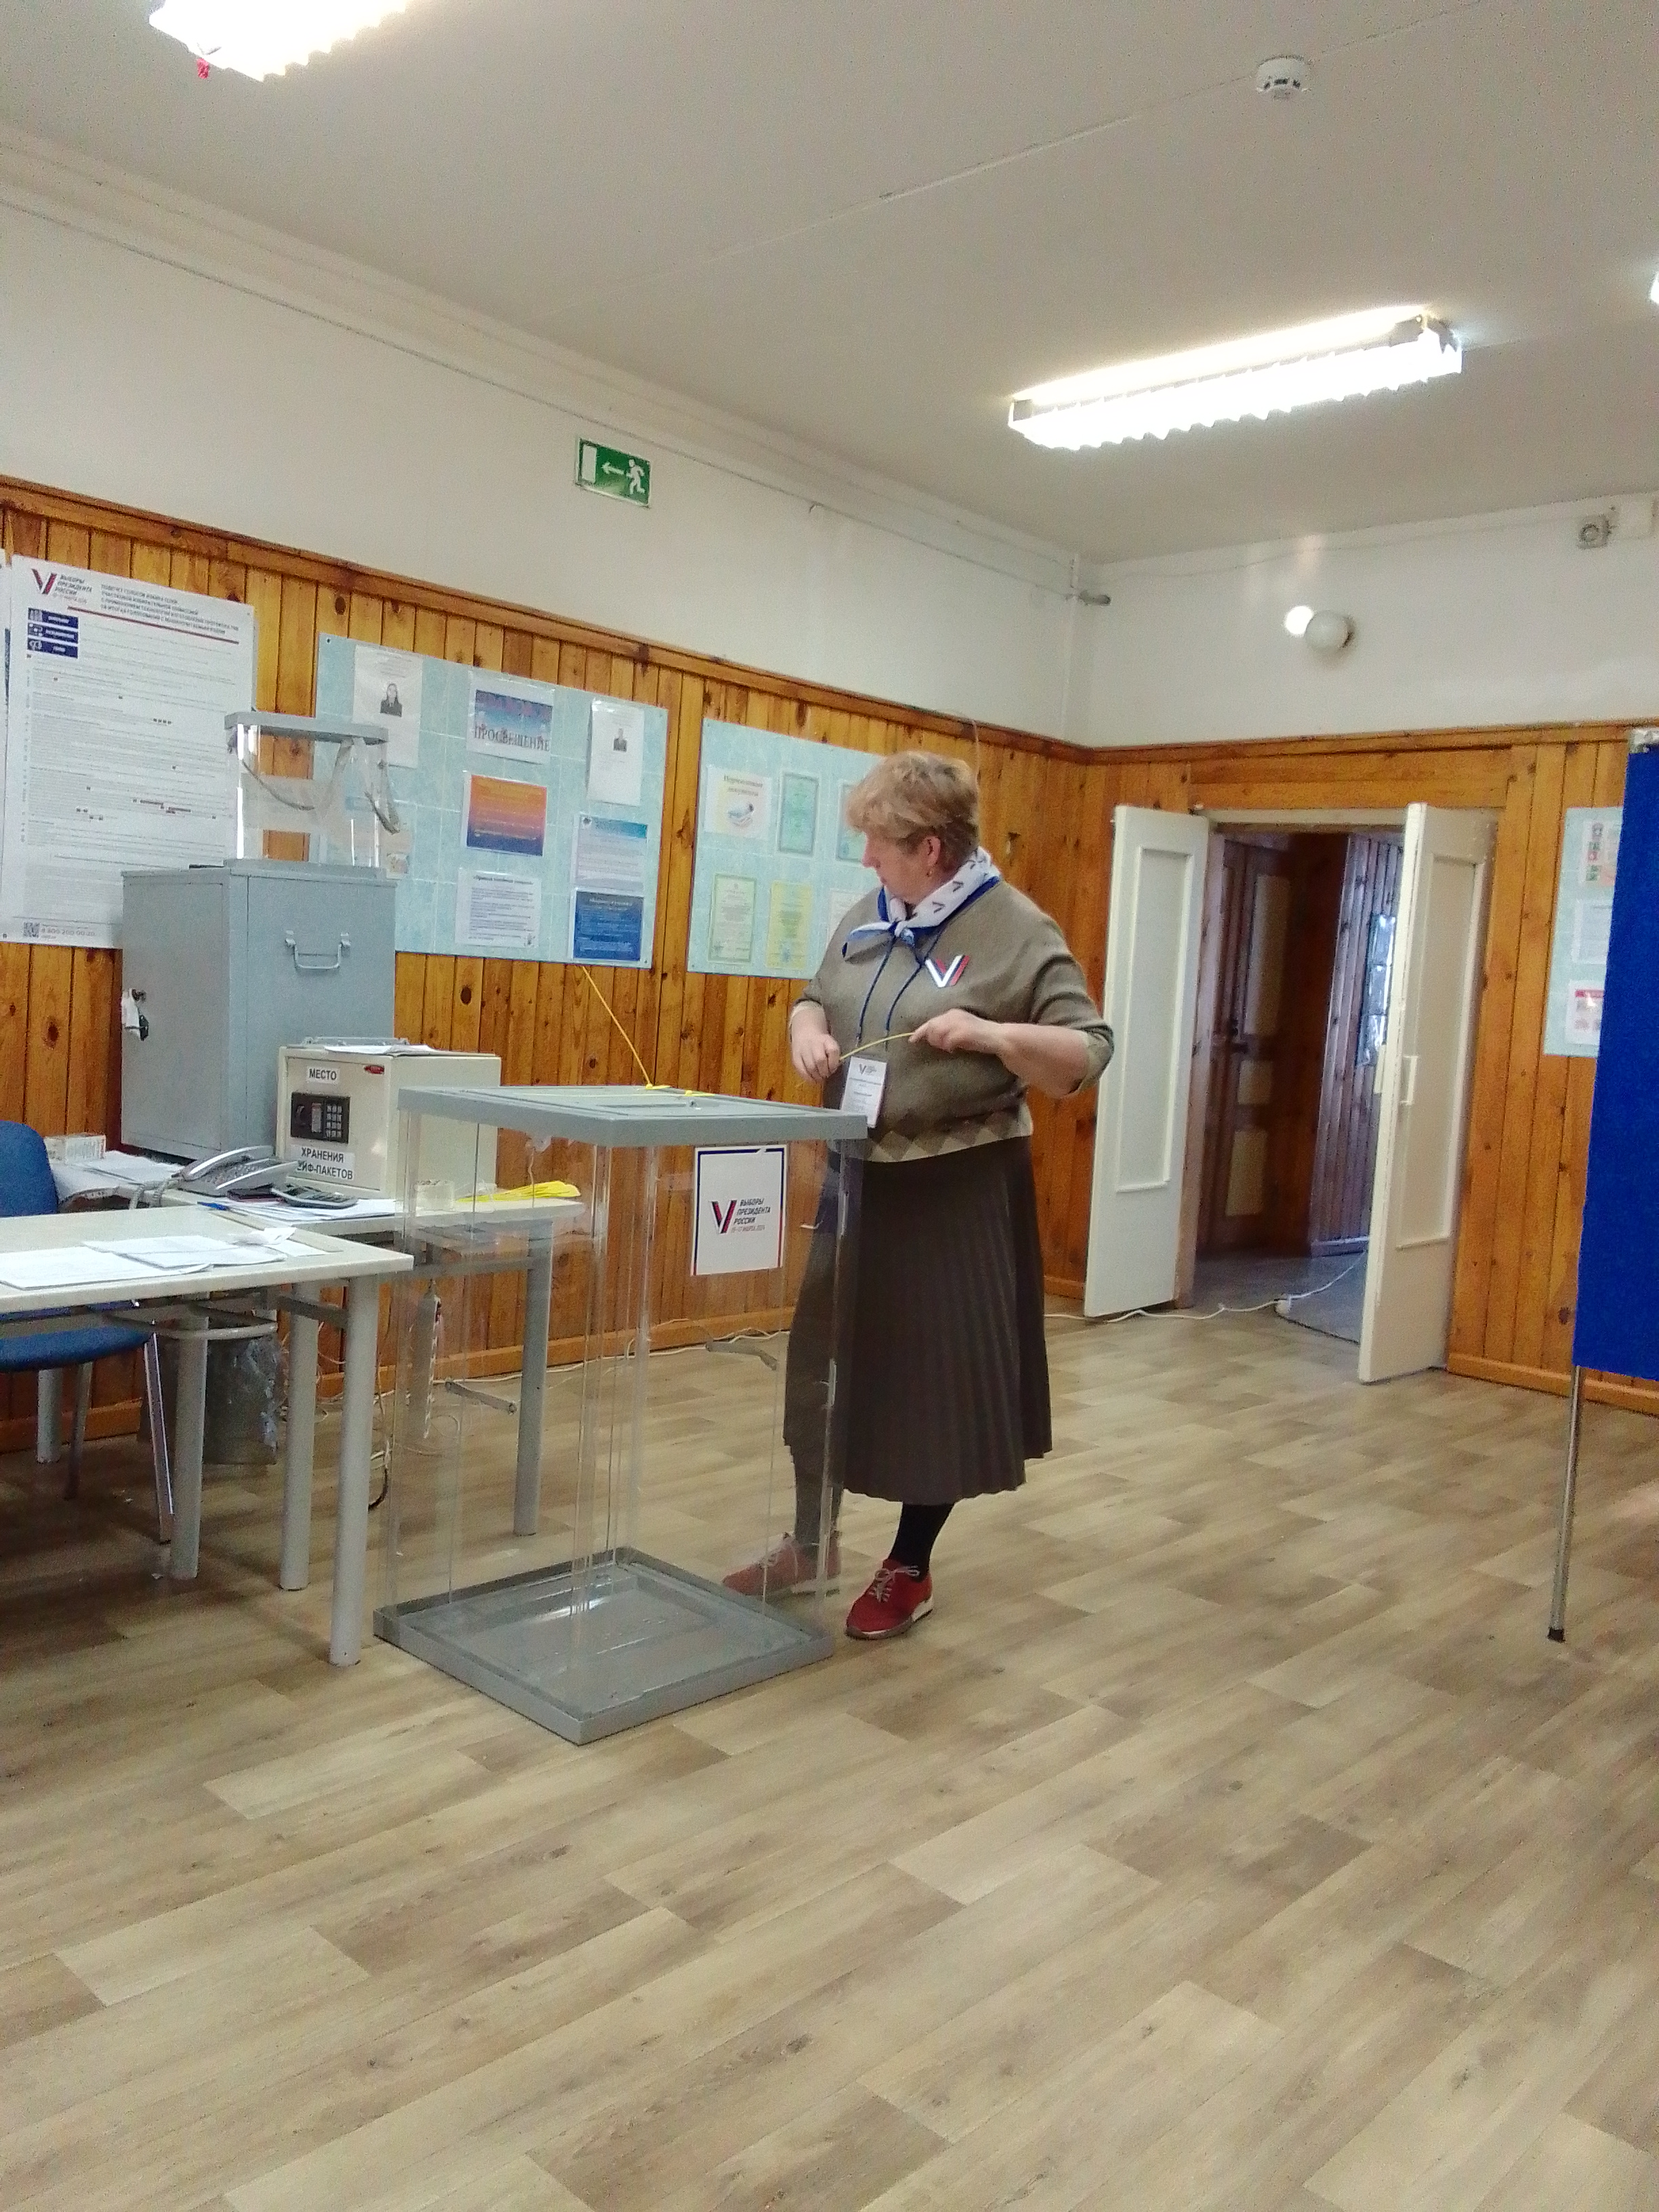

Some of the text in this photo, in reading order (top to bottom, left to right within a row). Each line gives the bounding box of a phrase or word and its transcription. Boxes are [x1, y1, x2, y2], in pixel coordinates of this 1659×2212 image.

[309, 1067, 337, 1081] МЕСТО
[301, 1147, 344, 1164] ХРАНЕНИЯ
[740, 1198, 764, 1206] ВЫБОРЫ
[737, 1206, 771, 1215] ПРЕЗИДЕНТА
